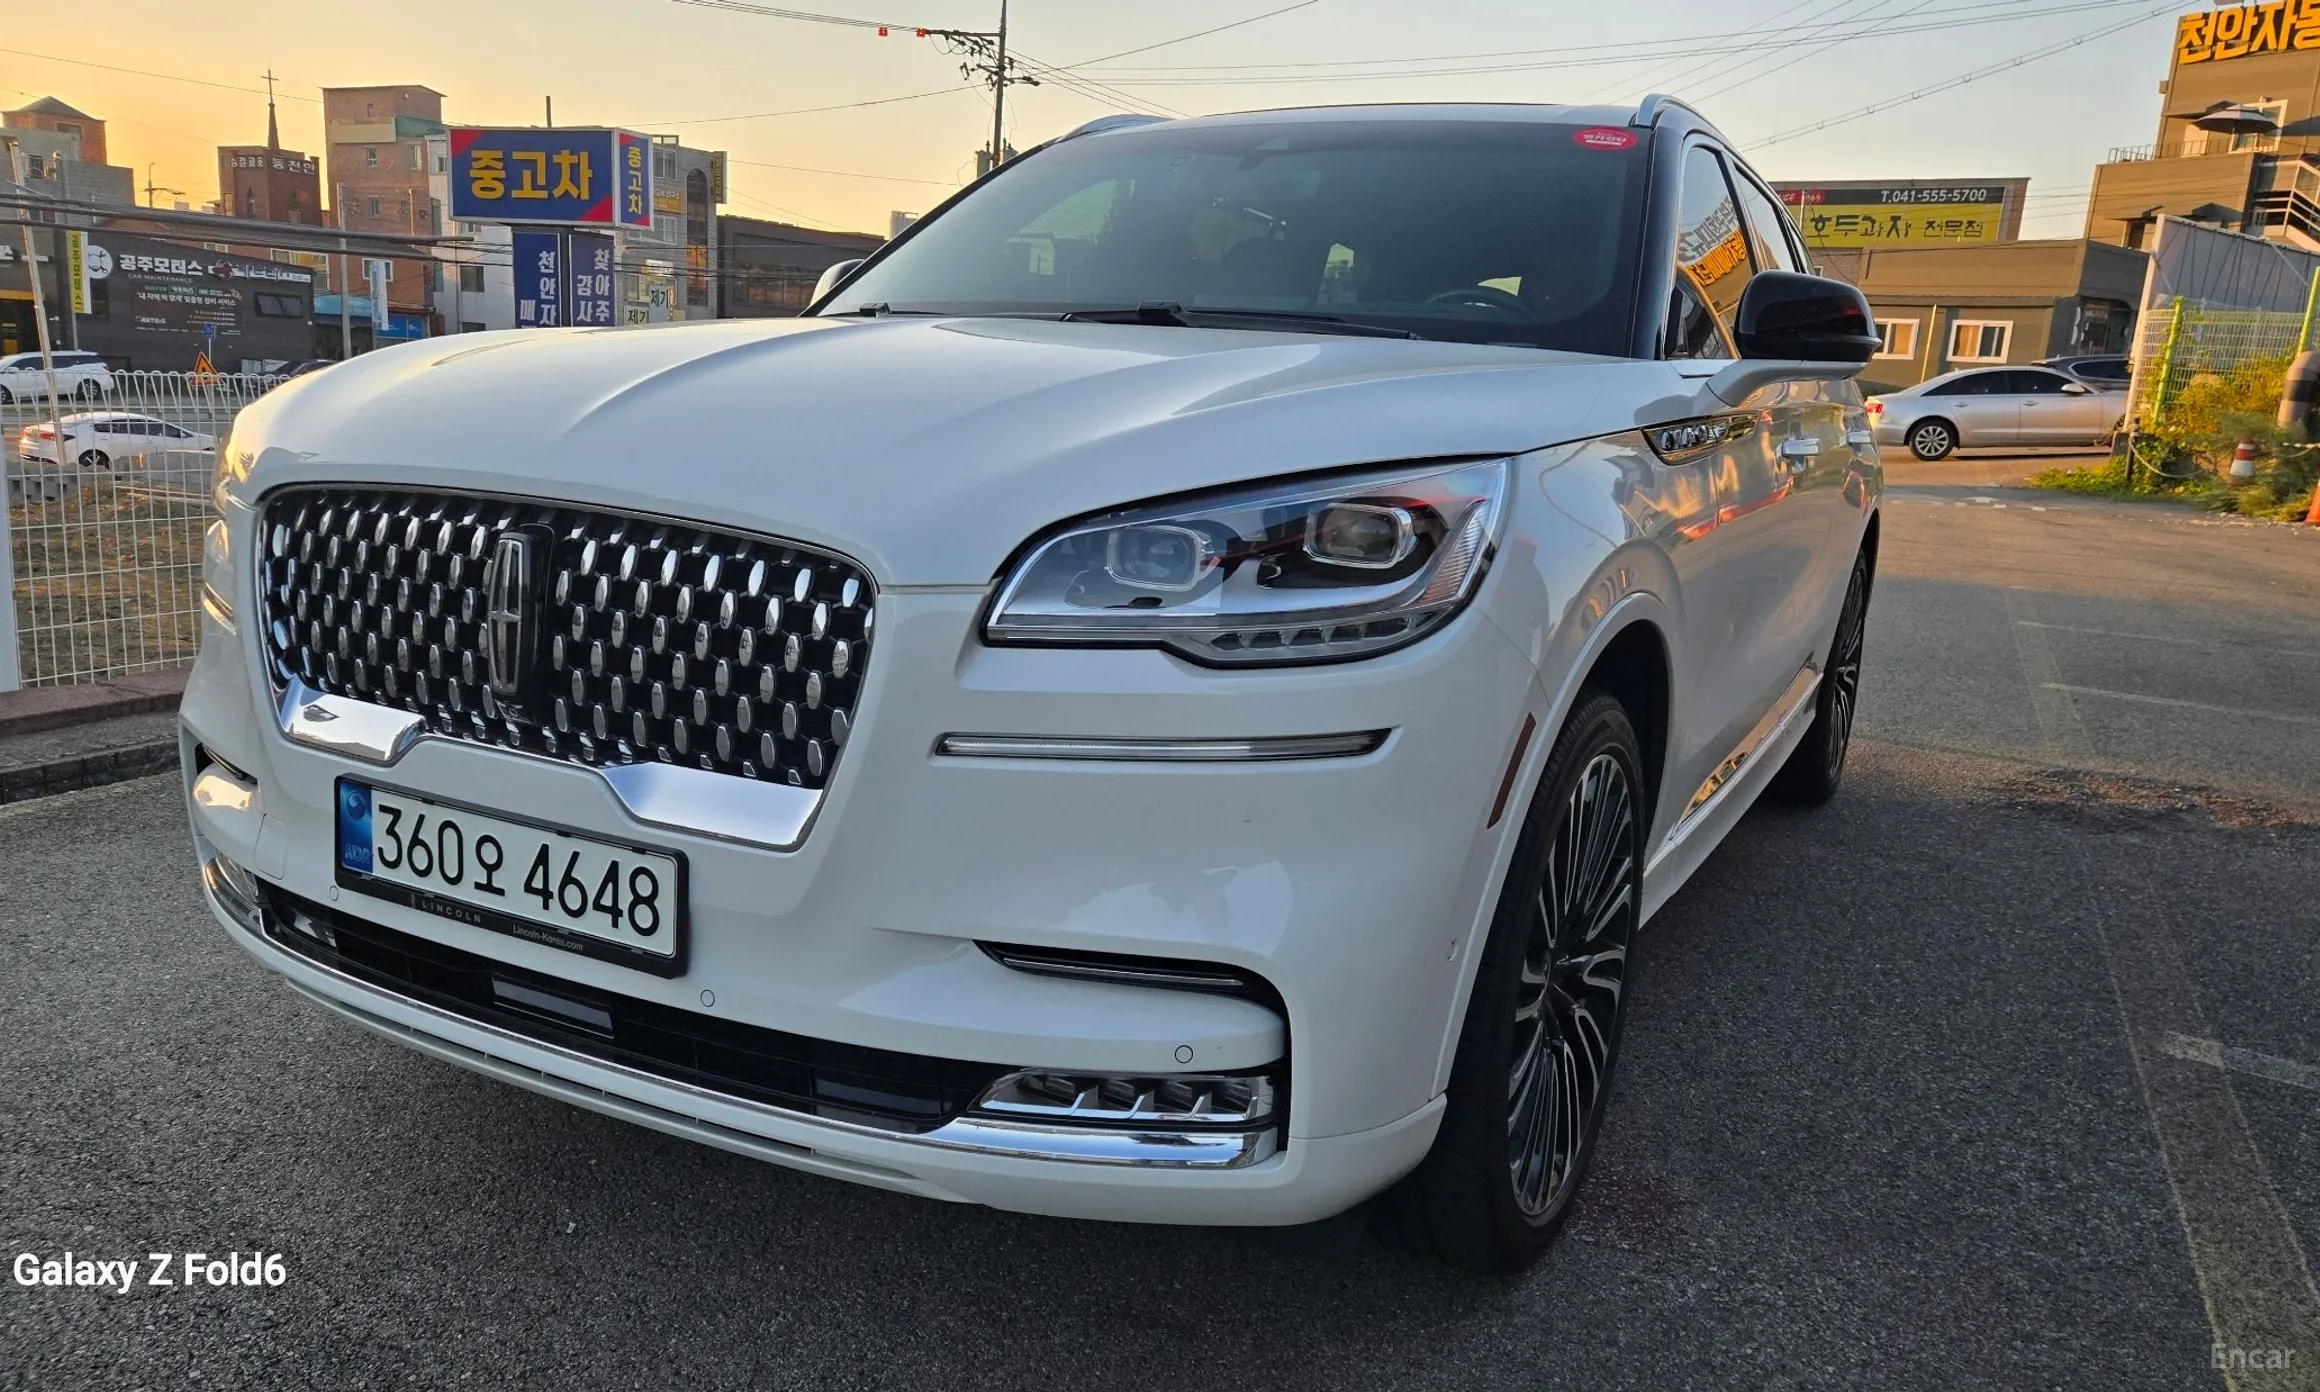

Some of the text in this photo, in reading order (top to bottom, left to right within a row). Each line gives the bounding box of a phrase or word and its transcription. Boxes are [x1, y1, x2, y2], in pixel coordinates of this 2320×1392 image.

[2178, 0, 2320, 65] 천안자동
[469, 149, 593, 201] 중고차
[627, 145, 643, 215] 중고차
[1880, 188, 1987, 204] T.041-555-5700
[1806, 214, 1983, 239] 호두과자 전문점
[119, 253, 203, 276] 공주모터스
[376, 804, 660, 937] 360오 4648
[421, 901, 482, 924] LINCOLN
[512, 924, 584, 951] Lincoln-Korea.com
